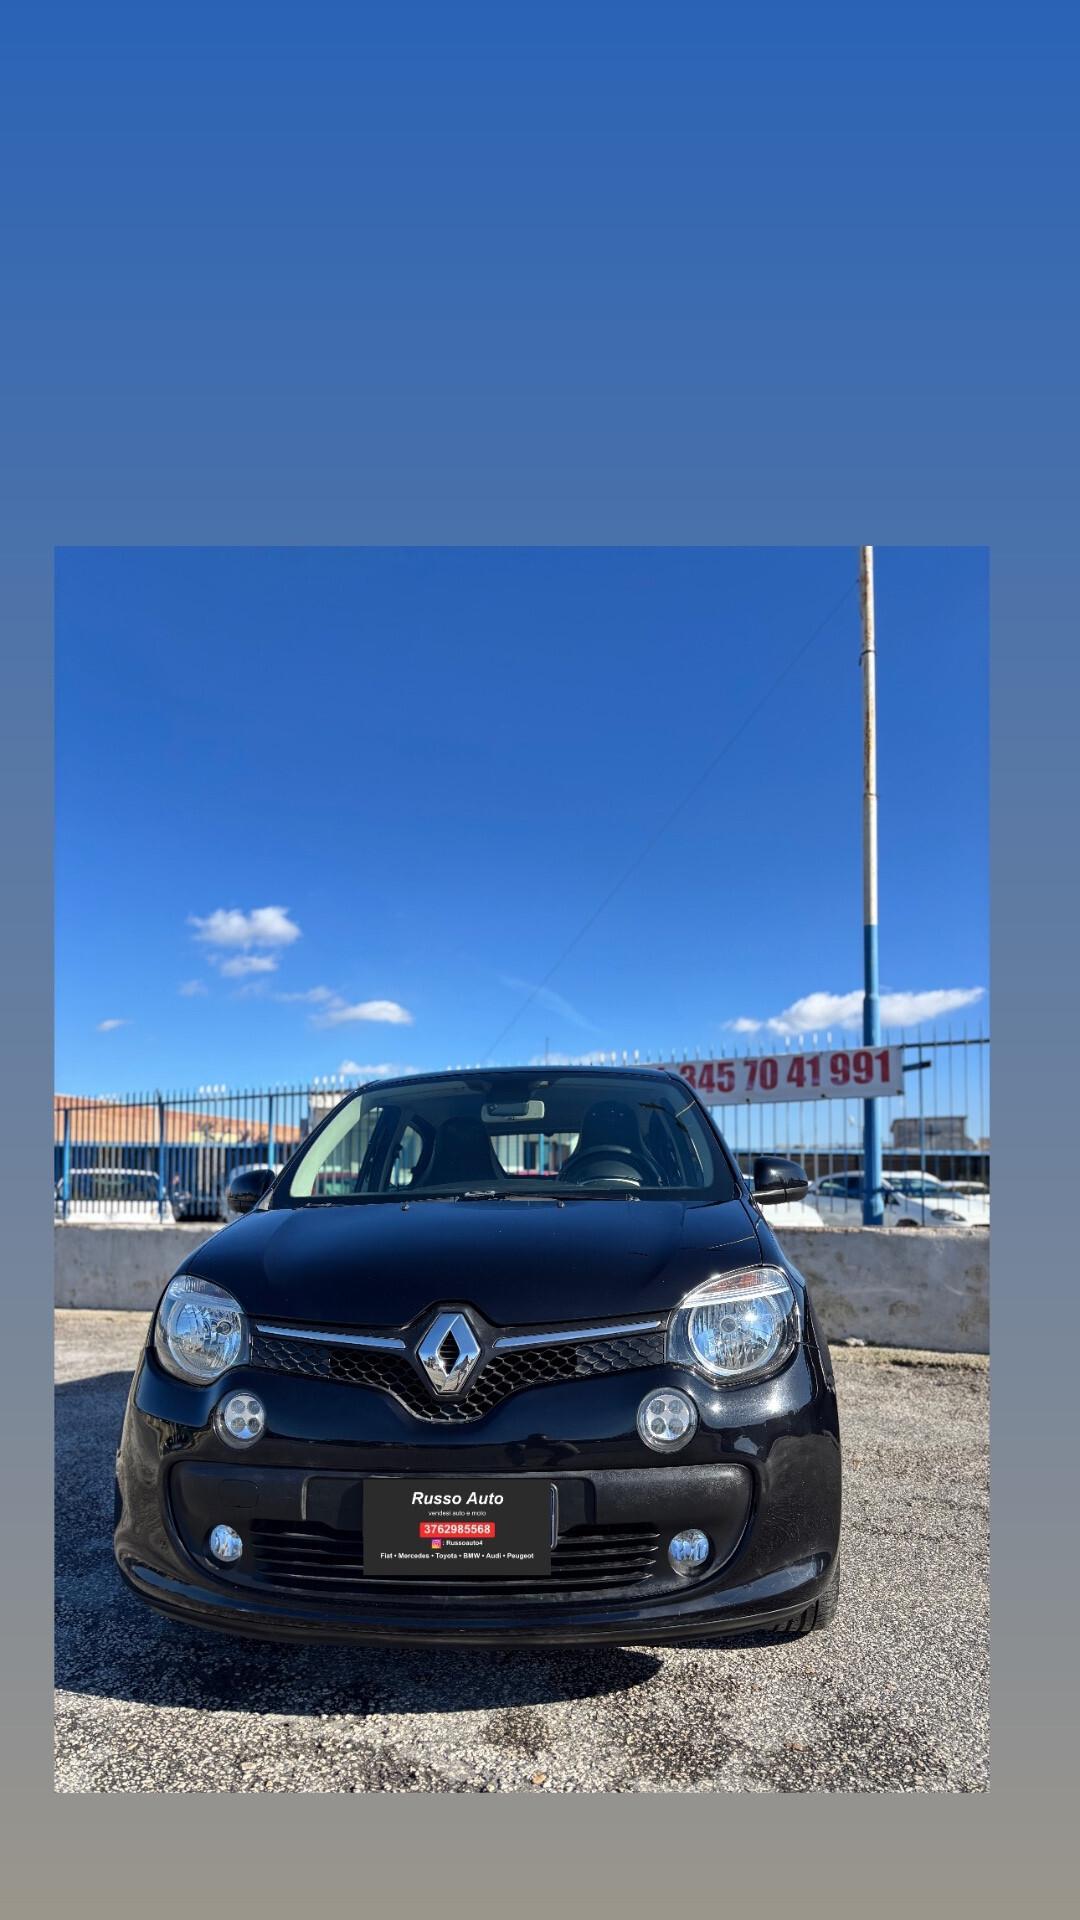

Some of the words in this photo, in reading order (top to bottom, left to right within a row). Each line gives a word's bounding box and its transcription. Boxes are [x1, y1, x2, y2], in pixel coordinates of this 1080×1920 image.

[680, 1062, 735, 1093] 345
[744, 1058, 778, 1091] 70
[787, 1055, 820, 1087] 41
[830, 1050, 890, 1085] 991
